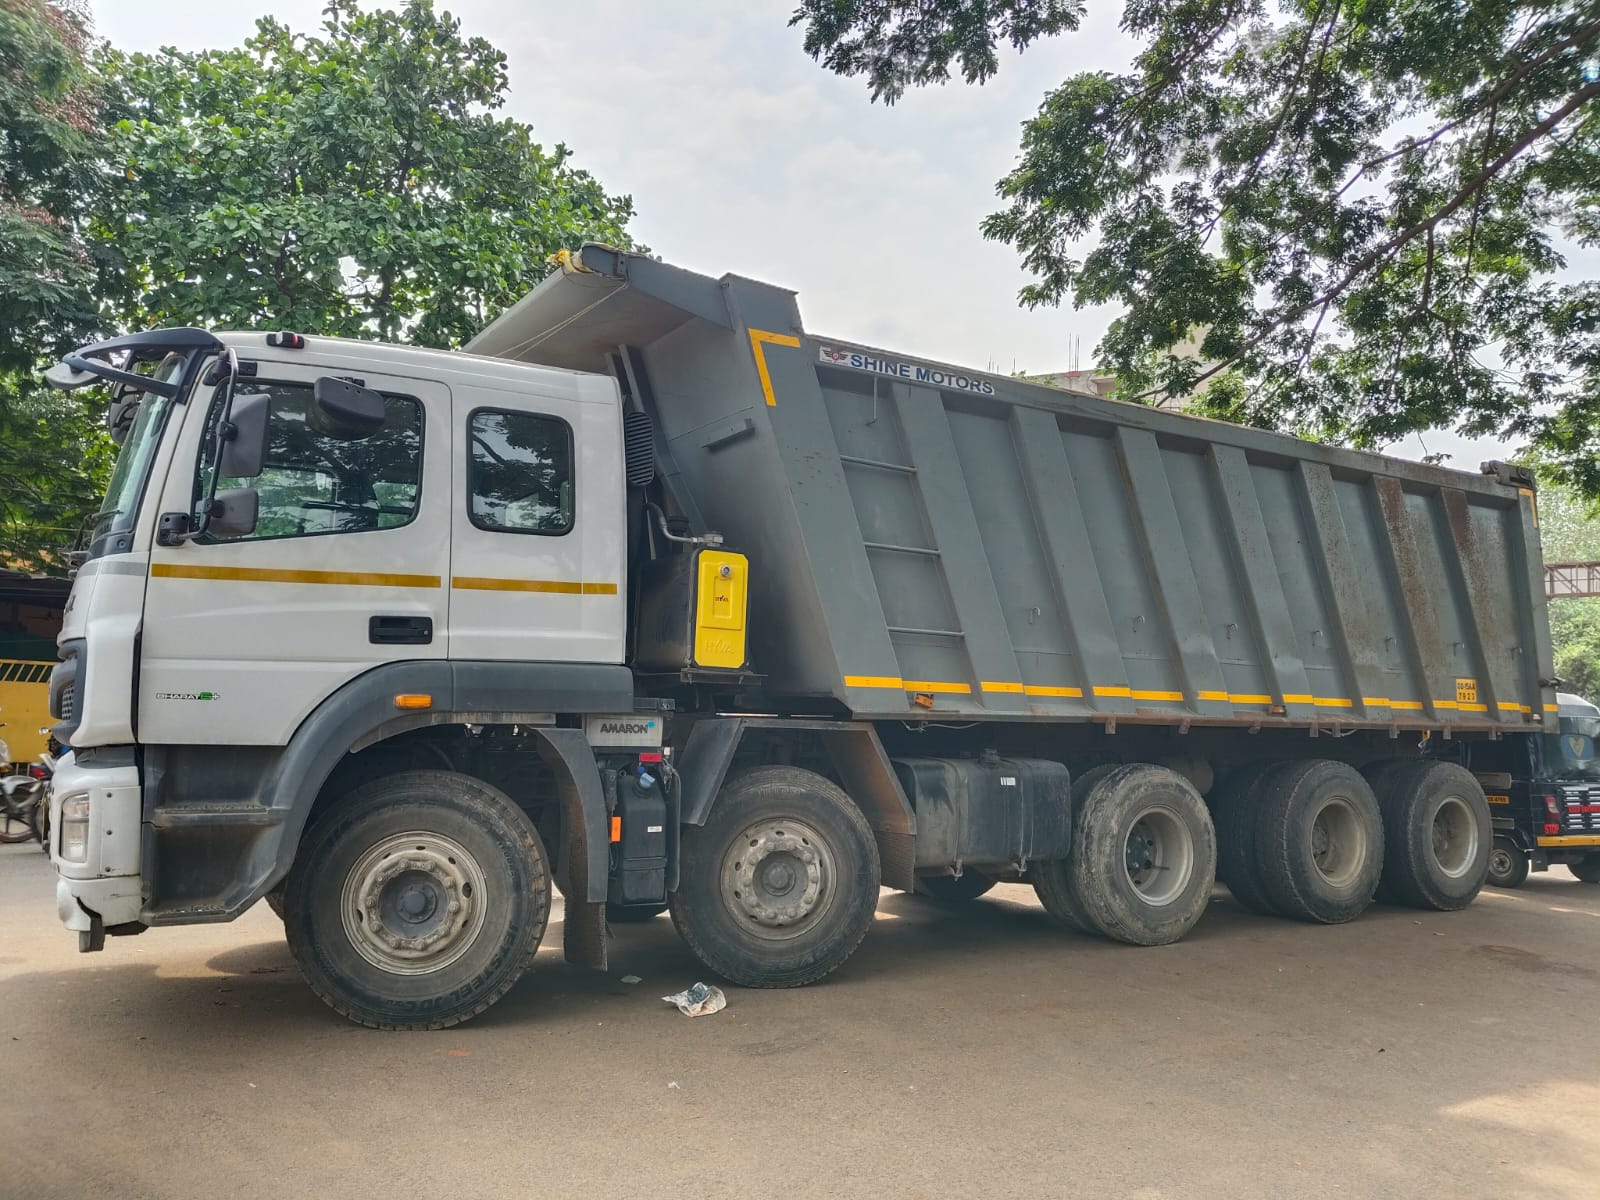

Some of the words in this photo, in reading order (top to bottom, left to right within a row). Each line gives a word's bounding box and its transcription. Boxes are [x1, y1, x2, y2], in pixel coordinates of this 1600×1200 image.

[851, 354, 910, 377] SHINE
[916, 367, 993, 394] MOTORS
[155, 692, 200, 700] BHARAT
[600, 723, 648, 734] AMARON
